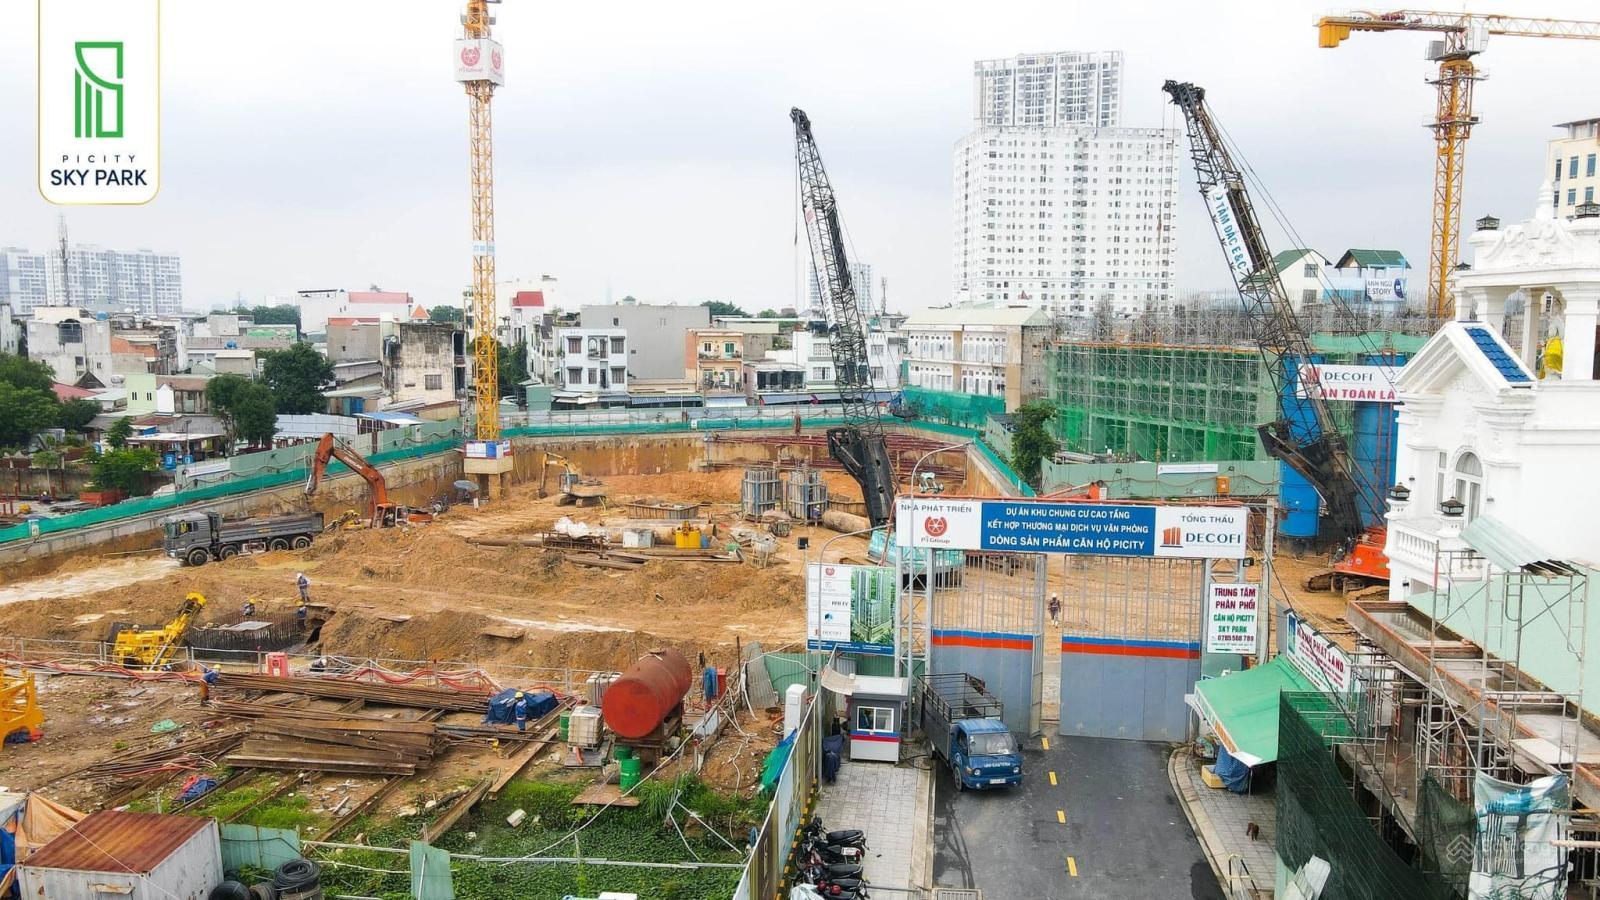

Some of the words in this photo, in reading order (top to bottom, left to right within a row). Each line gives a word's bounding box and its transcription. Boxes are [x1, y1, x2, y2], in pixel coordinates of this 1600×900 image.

[1324, 372, 1372, 382] DECOFI
[1342, 388, 1376, 400] TOÀN
[1018, 506, 1028, 516] ÁN
[1030, 508, 1048, 516] KHU
[1049, 508, 1076, 518] CHUNG
[1091, 510, 1107, 518] CAO
[990, 534, 1017, 546] DÒNG
[1020, 535, 1040, 546] SẢN
[1043, 534, 1070, 548] PHẨM
[1096, 538, 1110, 550] HỘ
[1113, 540, 1145, 550] PICITY
[1186, 532, 1241, 544] DECOFI
[1214, 588, 1238, 597] TRUNG
[1240, 586, 1256, 597] TÂM
[1216, 599, 1236, 609] PHÂN
